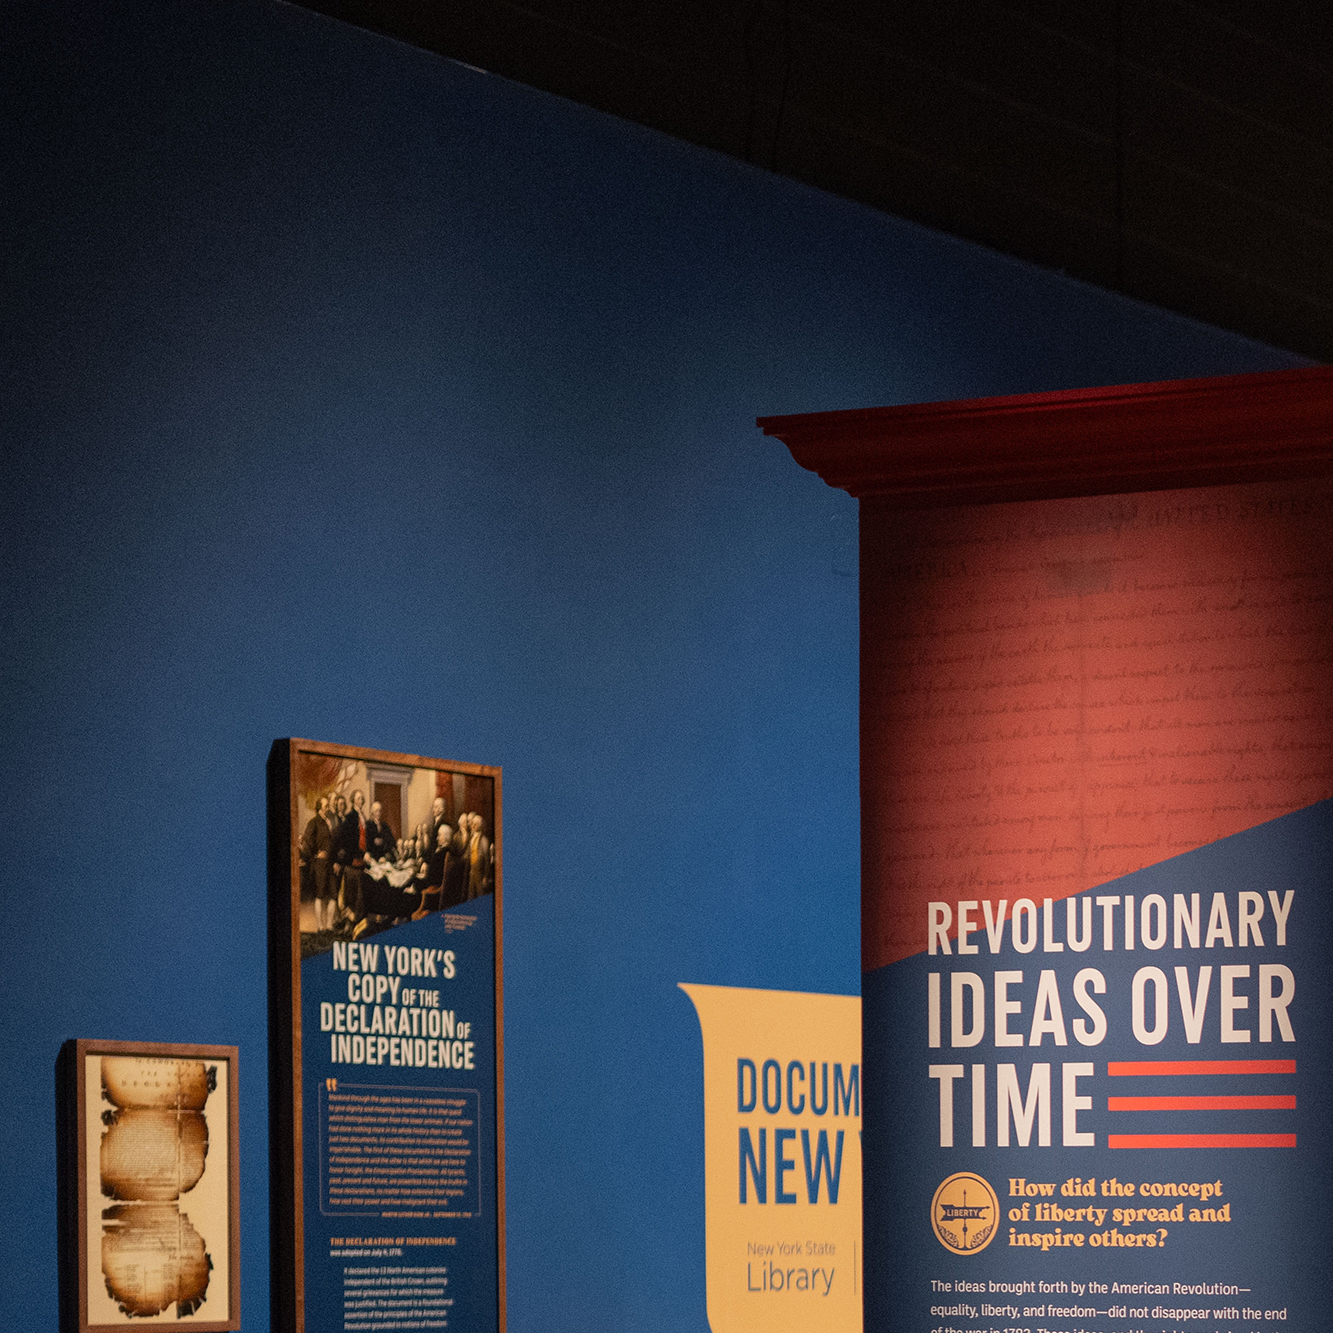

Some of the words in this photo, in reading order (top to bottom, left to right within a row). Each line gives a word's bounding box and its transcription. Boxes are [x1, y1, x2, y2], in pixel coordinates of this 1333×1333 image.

[928, 890, 1295, 955] REVOLUTIONARY
[333, 941, 378, 973] NEW
[384, 945, 456, 979] YORK'S
[348, 973, 400, 1005] COPY
[402, 988, 416, 1006] OF
[419, 989, 439, 1007] THE
[928, 967, 1108, 1048] IDEAS
[1131, 964, 1296, 1045] OVER
[320, 1002, 454, 1039] DECLARATION
[457, 1022, 471, 1039] OF
[331, 1034, 475, 1070] INDEPENDENCE
[929, 1062, 1095, 1148] TIME
[739, 1127, 844, 1205] NEW
[1008, 1178, 1056, 1197] How
[1060, 1177, 1096, 1197] did
[1100, 1177, 1135, 1197] the
[1139, 1179, 1223, 1201] concept
[946, 1208, 979, 1218] LIBERTY
[1007, 1202, 1030, 1222] of
[1034, 1202, 1108, 1226] liberty
[1111, 1202, 1184, 1226] spread
[1188, 1202, 1231, 1223] and
[747, 1241, 774, 1256] New
[777, 1241, 802, 1256] York
[805, 1240, 836, 1256] State
[1008, 1227, 1085, 1251] inspire
[1088, 1227, 1168, 1248] others?
[747, 1261, 835, 1296] Library
[930, 1279, 952, 1293] The
[954, 1279, 986, 1293] ideas
[988, 1280, 1035, 1296] brought
[1038, 1280, 1068, 1294] forth
[1070, 1280, 1085, 1297] by
[1087, 1281, 1108, 1295] the
[1110, 1281, 1169, 1295] American
[1172, 1282, 1251, 1296] Revolution—
[930, 1303, 978, 1319] equality,
[981, 1303, 1020, 1320] liberty,
[1022, 1304, 1045, 1317] and
[1047, 1304, 1126, 1319] freedom—did
[1129, 1306, 1148, 1319] not
[1150, 1305, 1210, 1322] disappear
[1212, 1306, 1239, 1320] with
[1241, 1306, 1262, 1320] the
[1264, 1307, 1286, 1321] end
